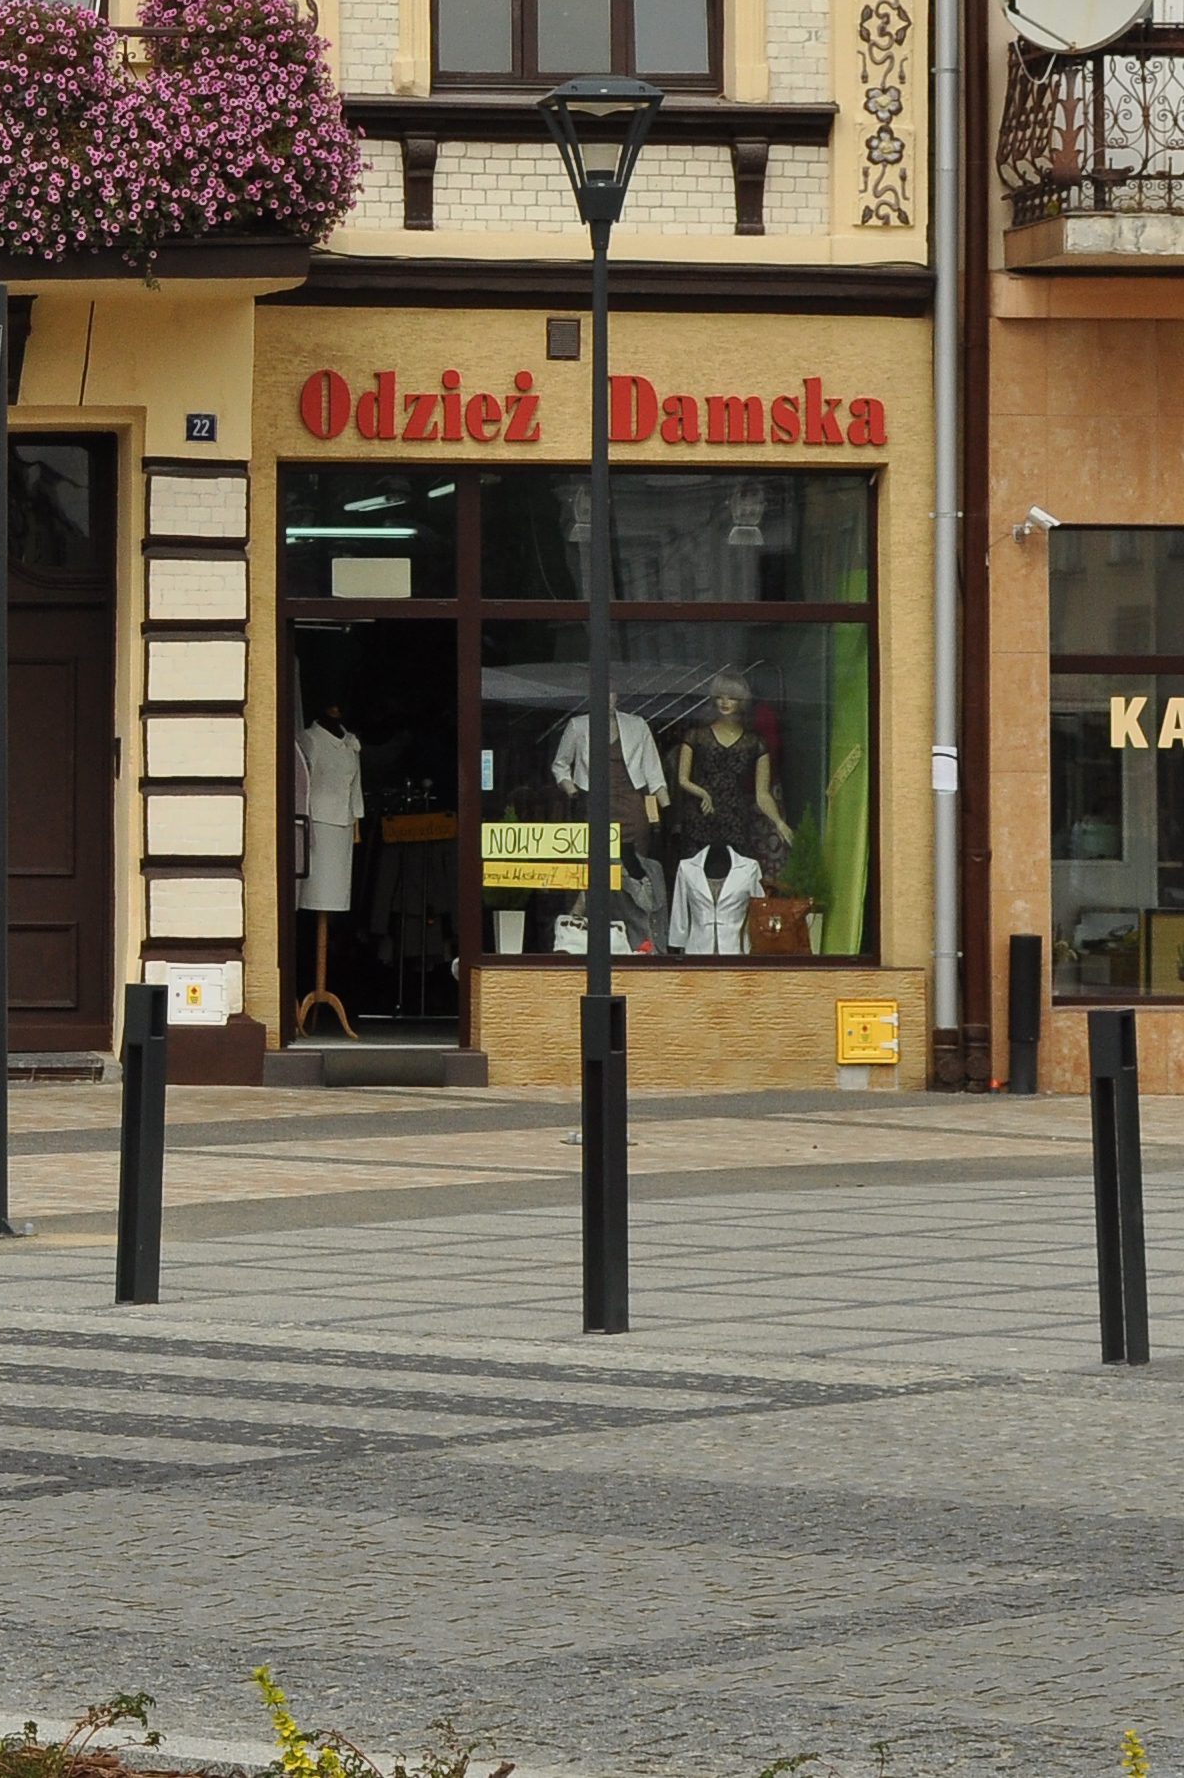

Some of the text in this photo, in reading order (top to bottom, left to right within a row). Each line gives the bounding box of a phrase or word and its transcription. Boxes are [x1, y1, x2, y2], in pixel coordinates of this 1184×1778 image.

[193, 419, 210, 436] 22
[299, 369, 888, 447] Odzież Damska
[1110, 697, 1184, 748] KA
[488, 827, 618, 855] NOWY SKLP
